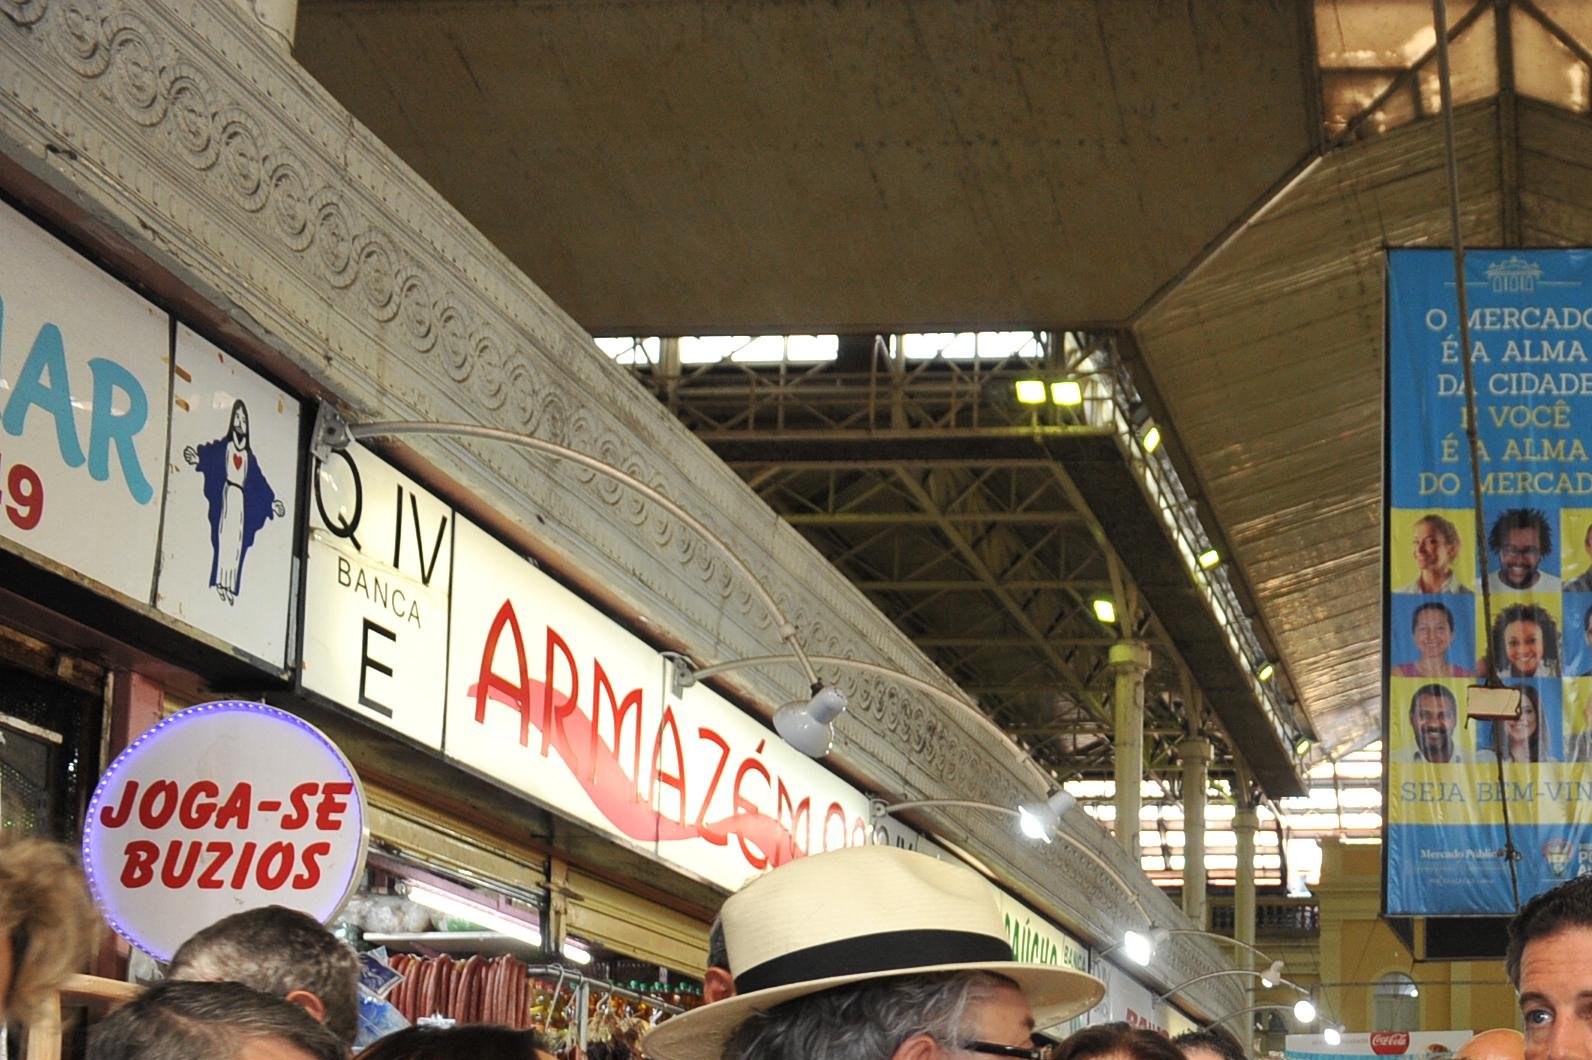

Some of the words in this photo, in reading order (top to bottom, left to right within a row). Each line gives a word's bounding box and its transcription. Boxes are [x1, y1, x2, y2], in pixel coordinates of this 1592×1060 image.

[1426, 308, 1448, 331] O
[1442, 334, 1459, 363] É
[1502, 340, 1588, 363] ALMA
[0, 295, 154, 506] AR
[1489, 400, 1571, 430] VOCÊ
[1441, 434, 1459, 463] É
[1502, 439, 1589, 462] ALMA
[0, 462, 45, 532] 9
[314, 448, 363, 552] Q
[1418, 472, 1461, 496] DO
[338, 556, 421, 629] BANCA
[358, 616, 397, 719] E
[474, 598, 809, 869] ARMAZÉM
[100, 779, 355, 831] JOGA-SE
[1400, 781, 1465, 803] SEJA
[120, 839, 331, 891] BUZIOS
[1372, 1033, 1407, 1047] Coca-Cola
